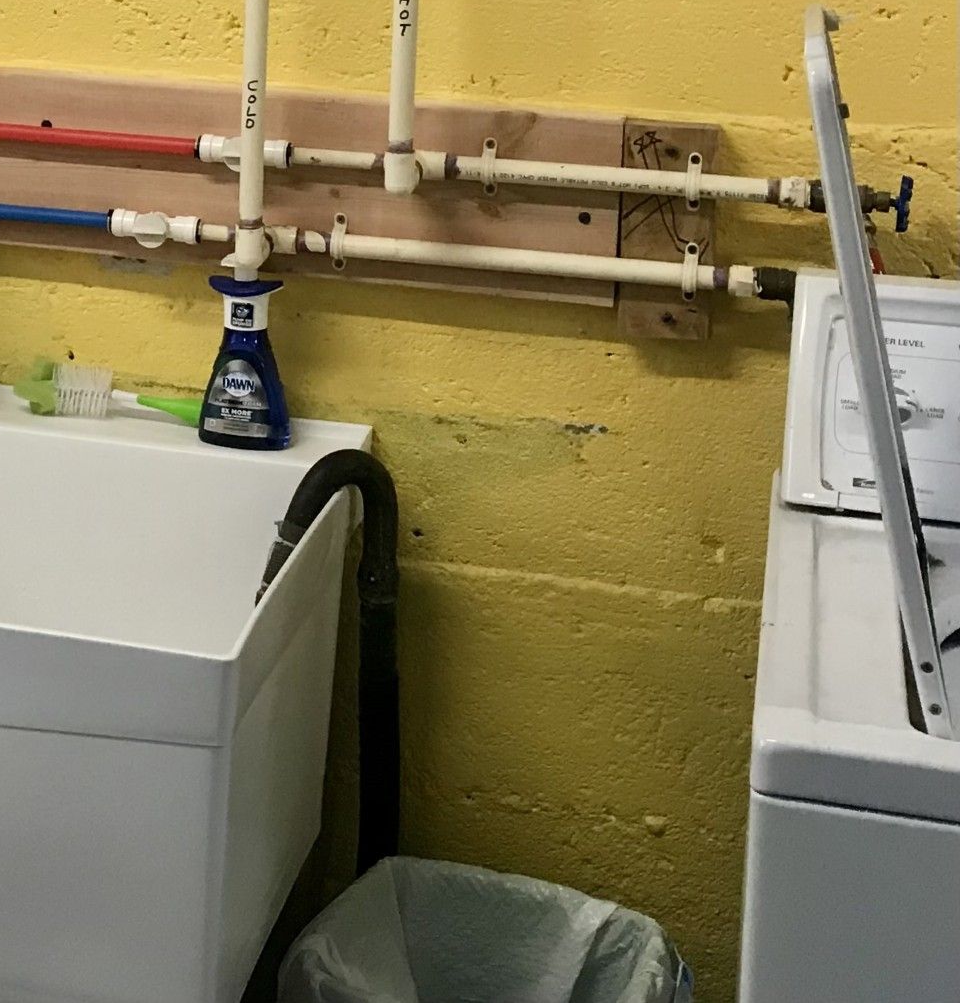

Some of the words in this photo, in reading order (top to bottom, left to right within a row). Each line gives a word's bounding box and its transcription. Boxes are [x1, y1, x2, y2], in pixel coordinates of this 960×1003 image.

[245, 80, 259, 129] COLD
[897, 338, 926, 348] LEVEL
[222, 377, 255, 392] DAWN
